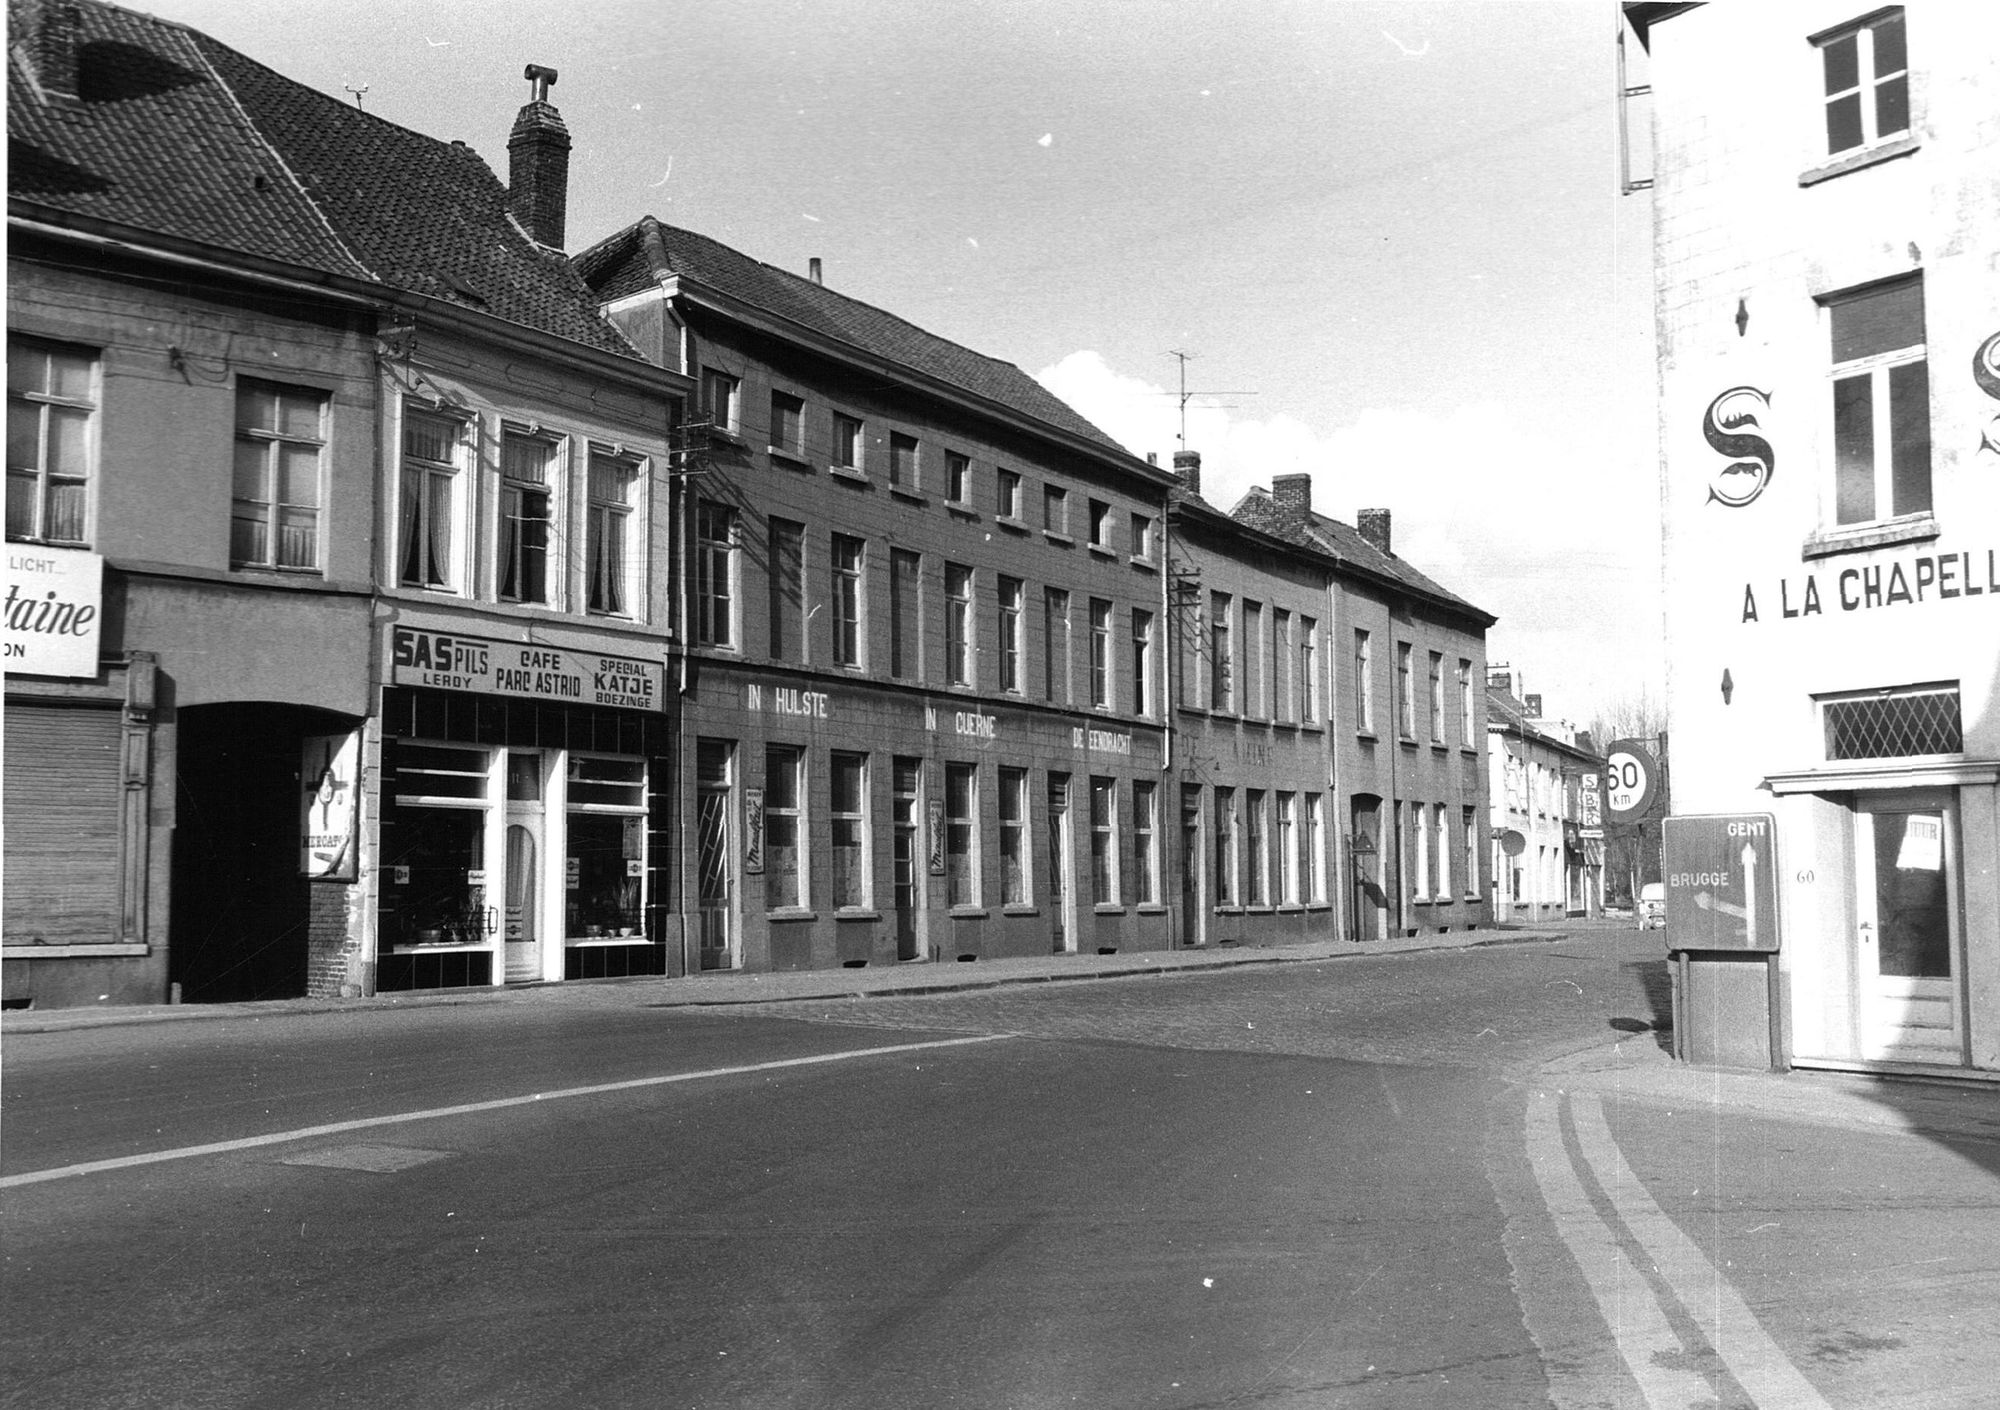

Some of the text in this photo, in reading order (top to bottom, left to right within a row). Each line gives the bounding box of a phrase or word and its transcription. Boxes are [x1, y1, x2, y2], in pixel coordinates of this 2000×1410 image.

[9, 556, 56, 574] LICHT
[1742, 549, 2000, 624] A LA CHAPELL
[395, 631, 489, 676] SAS PILS
[520, 650, 561, 671] CAFE
[600, 659, 648, 678] SPECIAL
[422, 672, 473, 689] LEROY
[496, 667, 581, 698] PARC ASTRID
[594, 672, 654, 696] KATJE
[596, 691, 652, 709] BOEZINGE
[748, 683, 828, 719] IN HULSTE
[925, 707, 936, 731] IN
[1073, 727, 1084, 749] DE
[1608, 761, 1638, 791] 60
[1613, 793, 1631, 806] km
[1727, 821, 1767, 837] GENT
[1669, 872, 1730, 888] BRUGGE
